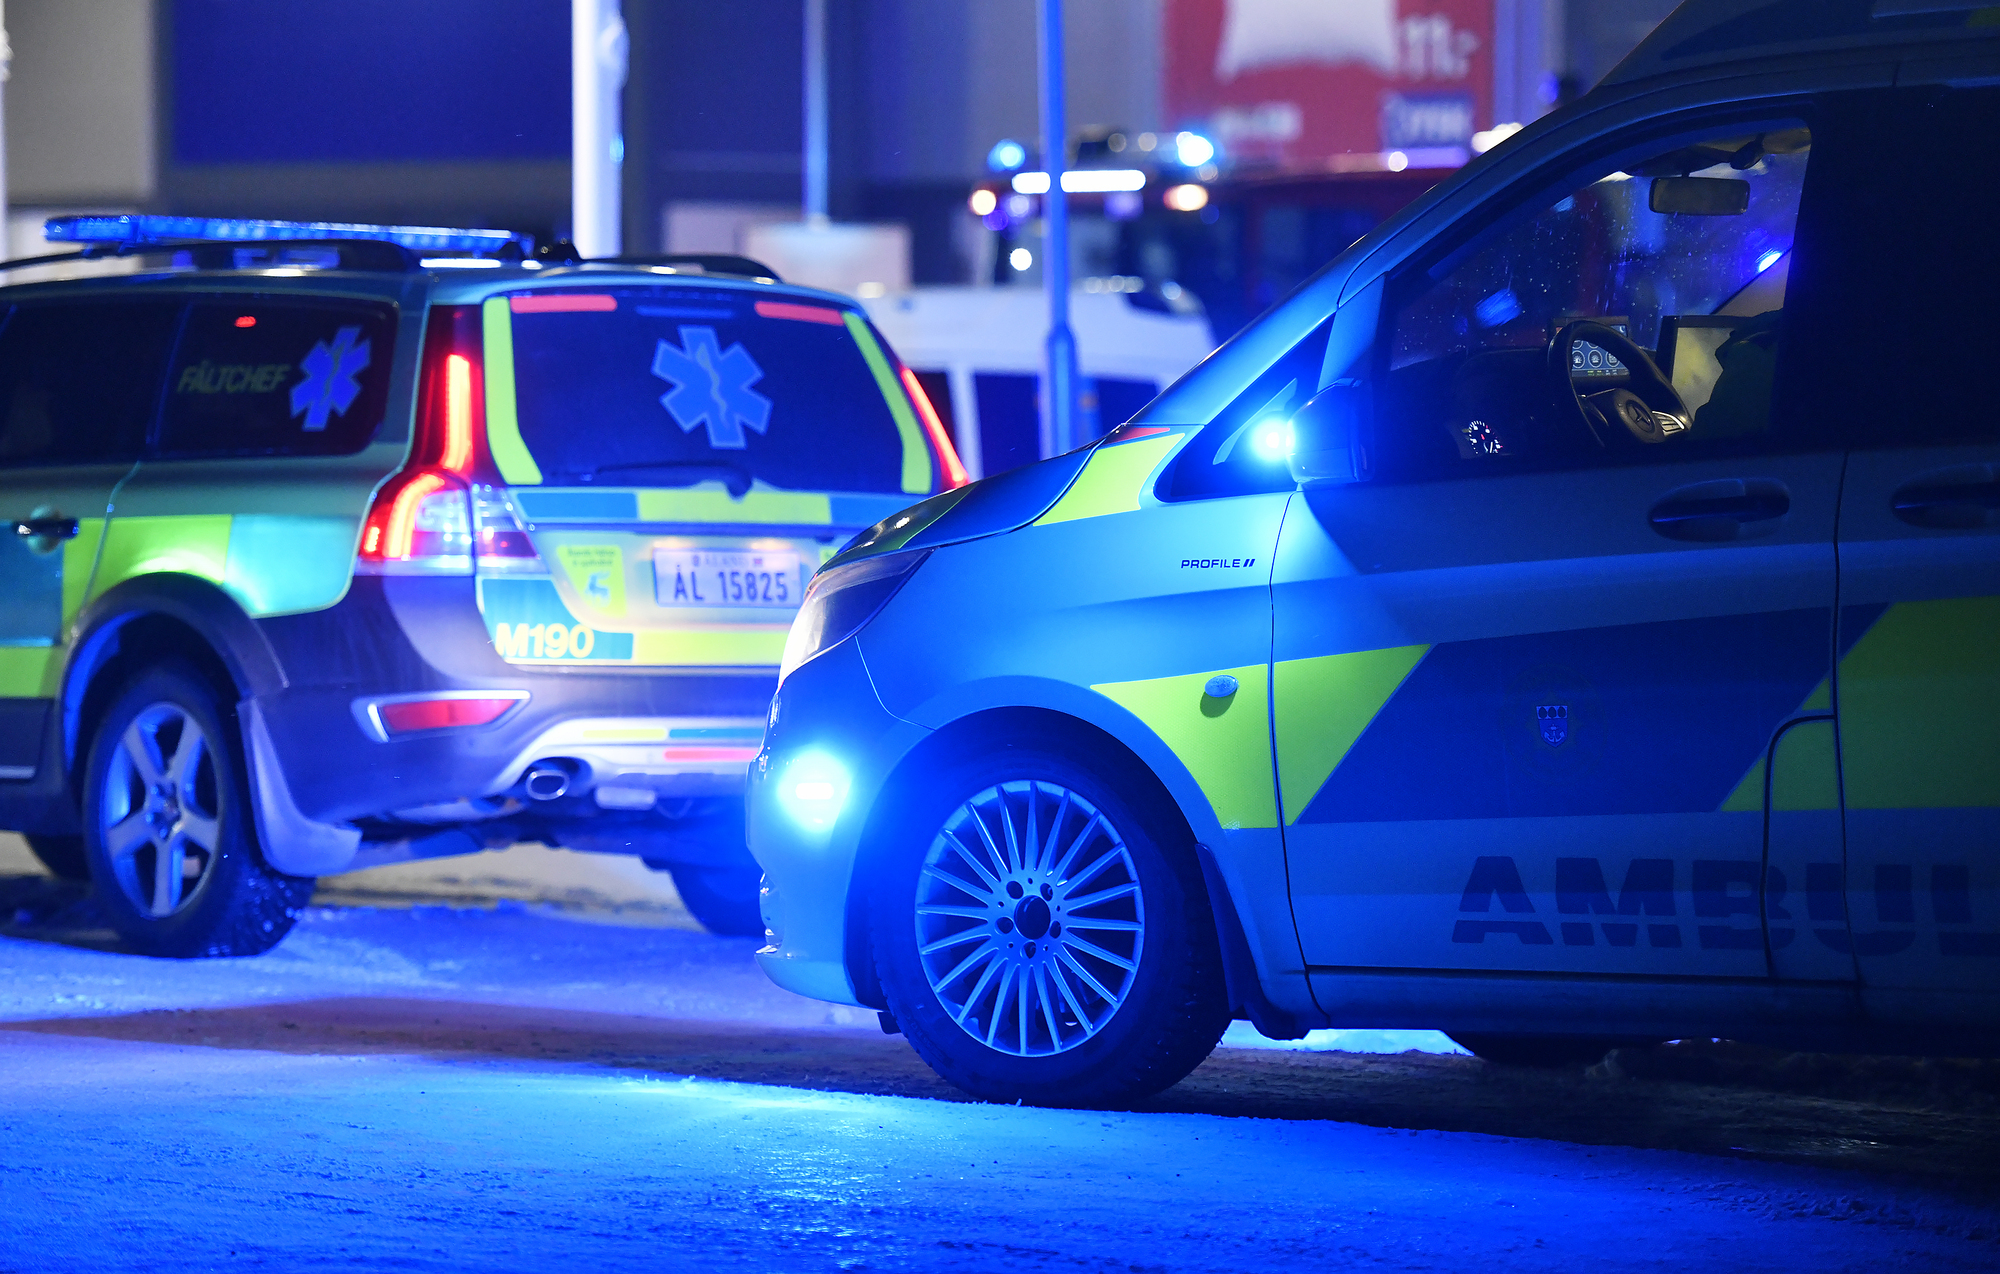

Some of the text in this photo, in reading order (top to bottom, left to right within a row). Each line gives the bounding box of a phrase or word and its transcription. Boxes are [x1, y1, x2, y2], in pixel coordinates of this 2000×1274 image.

[674, 564, 788, 603] ÅL 15825
[495, 623, 595, 659] M190
[1452, 855, 2000, 957] AMBUL
